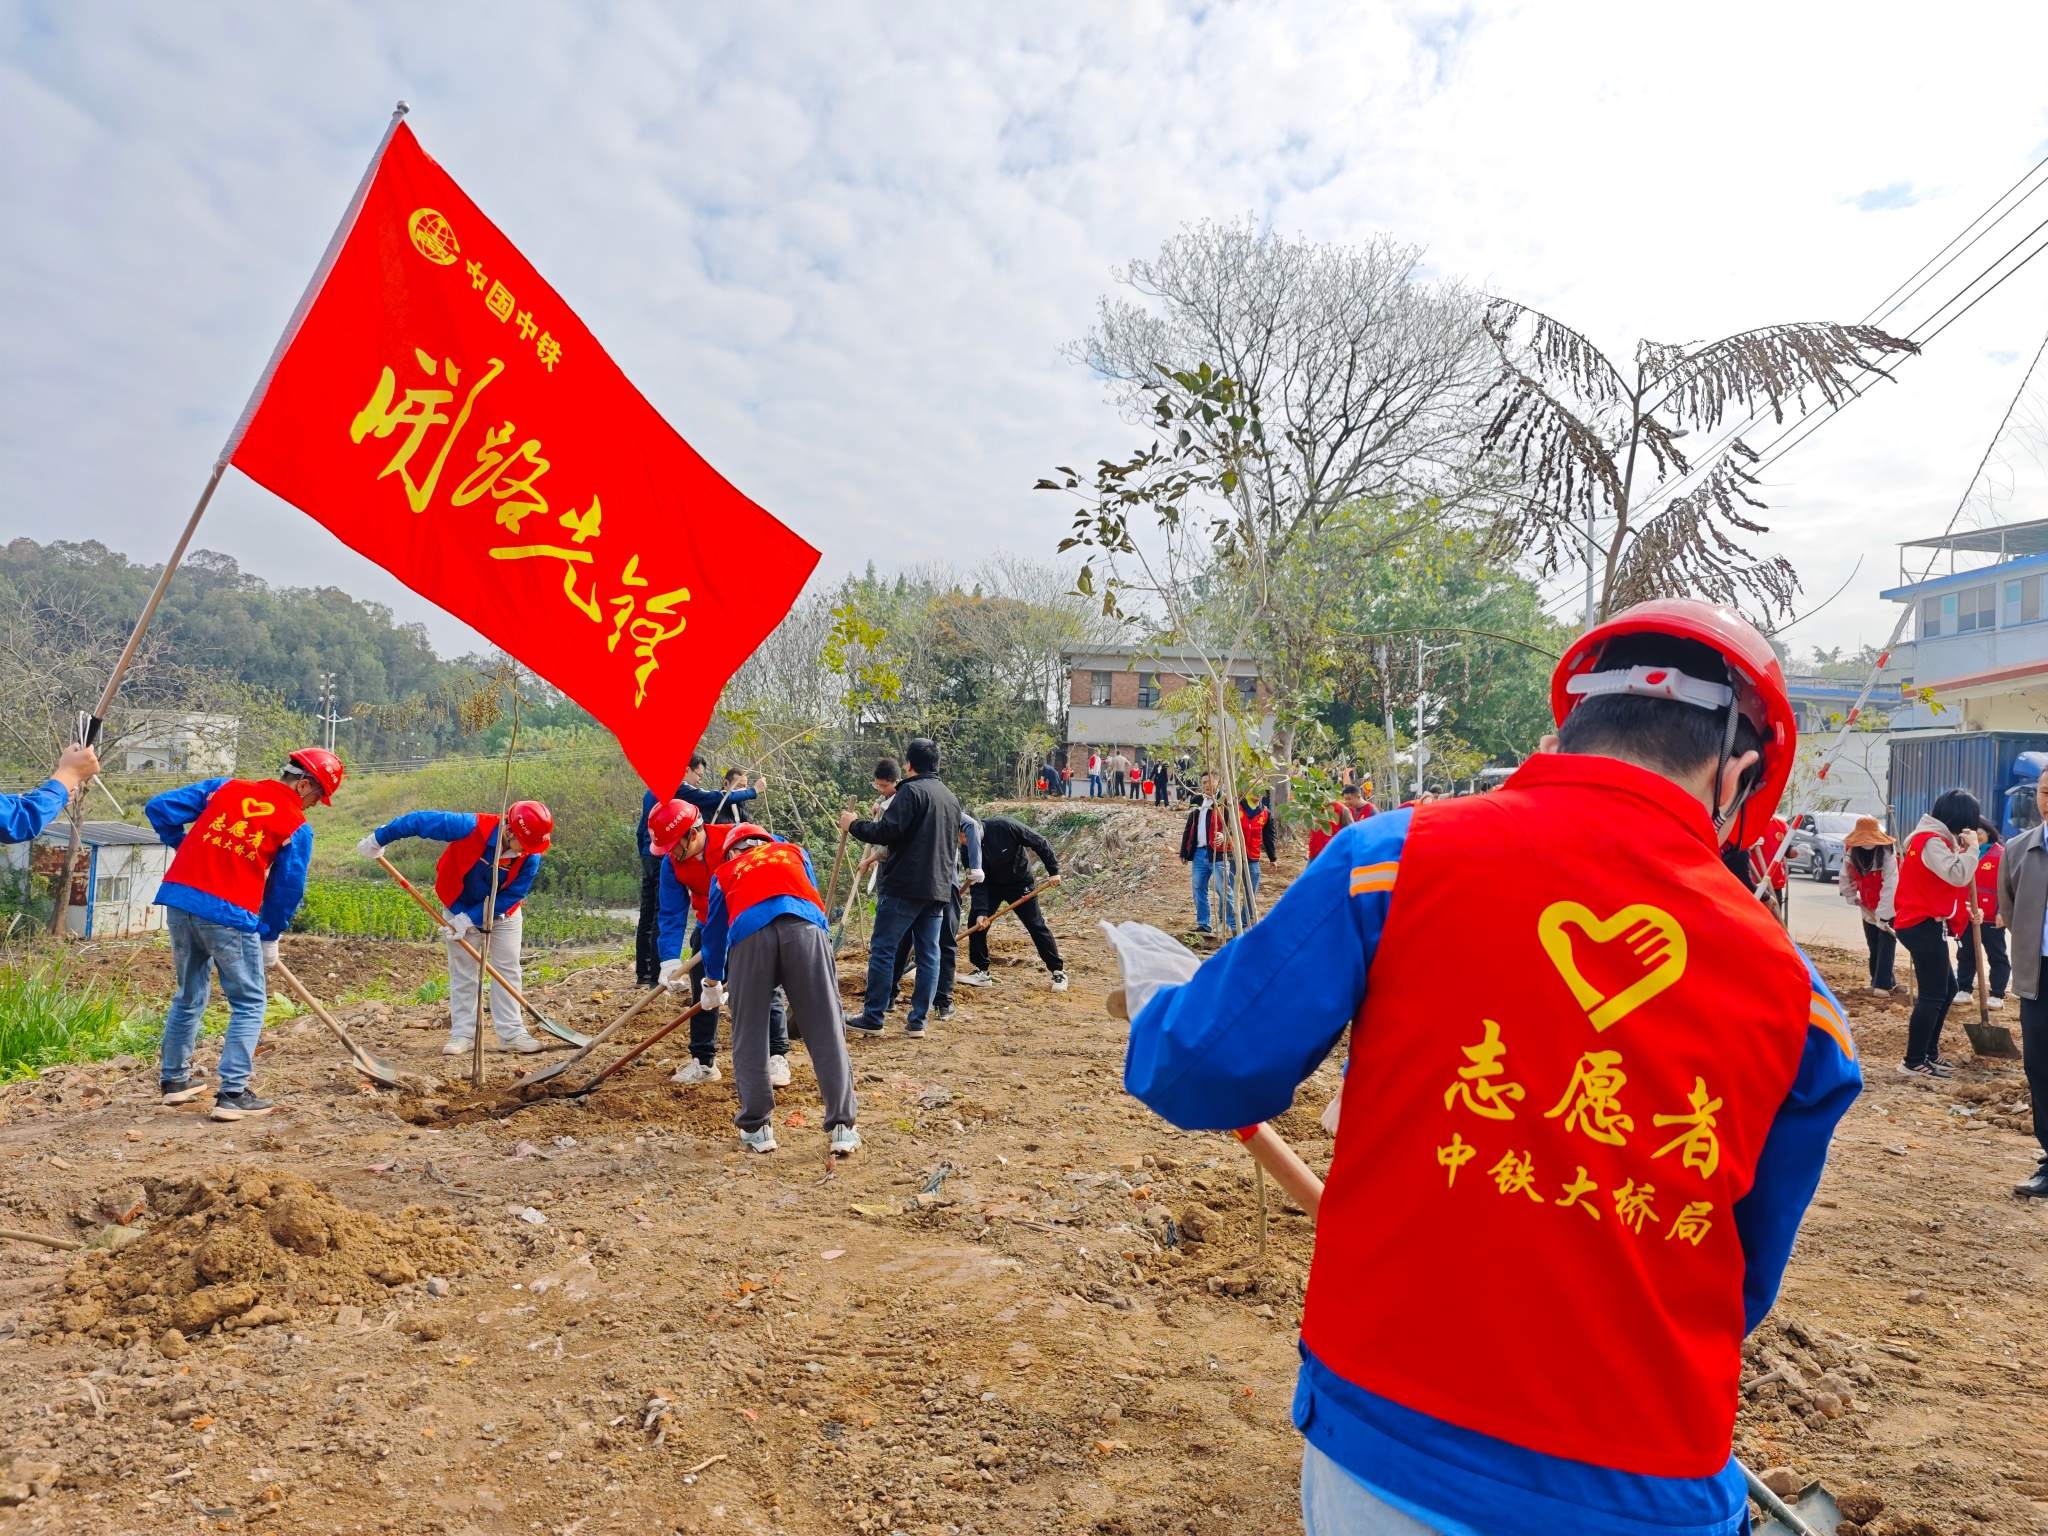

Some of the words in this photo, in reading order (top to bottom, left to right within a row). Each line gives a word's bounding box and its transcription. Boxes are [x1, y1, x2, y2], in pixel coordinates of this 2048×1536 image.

[466, 260, 562, 372] 中国中铁
[208, 813, 265, 849] 志愿者
[1444, 1019, 1723, 1179] 志愿者
[1437, 1133, 1713, 1246] 中铁大桥局
